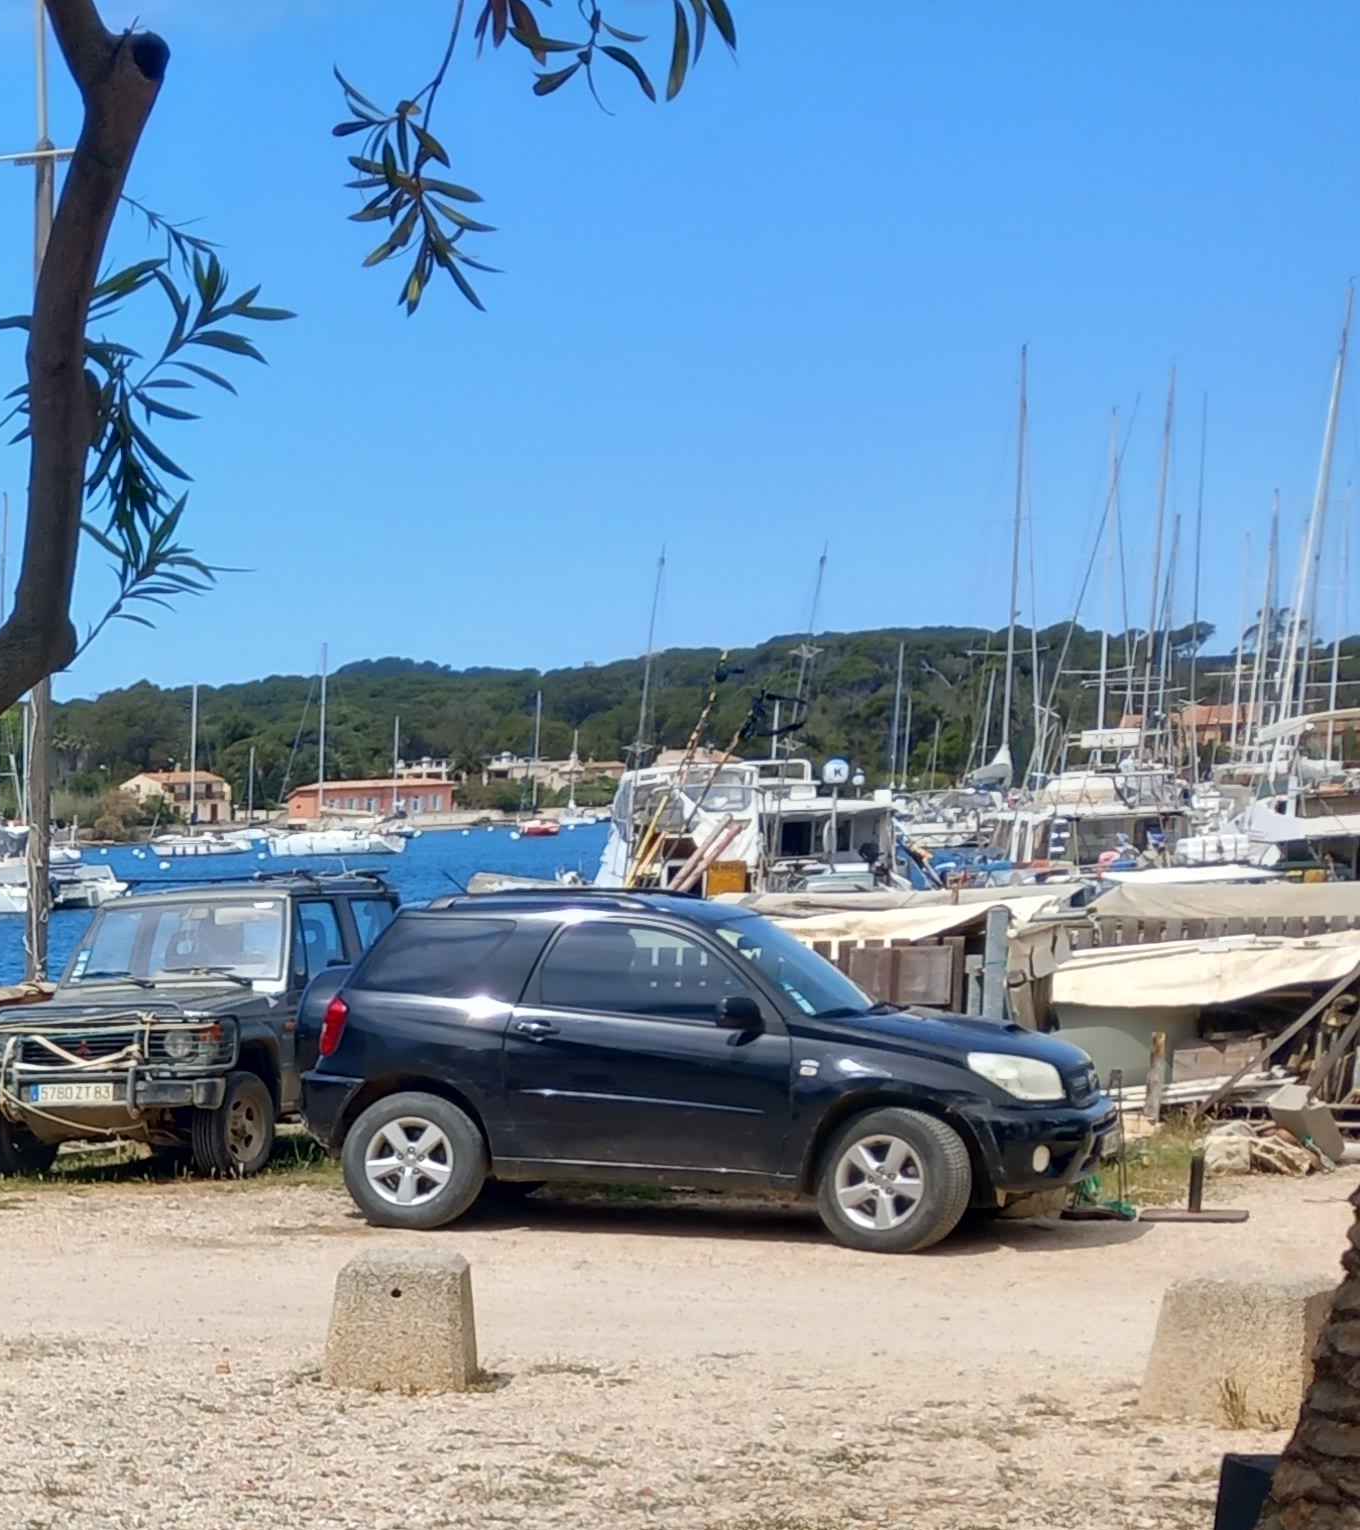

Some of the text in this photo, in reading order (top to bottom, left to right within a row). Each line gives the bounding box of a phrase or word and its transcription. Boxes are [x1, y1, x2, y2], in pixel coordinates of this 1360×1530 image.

[40, 1085, 111, 1100] 5780 ZT 83
